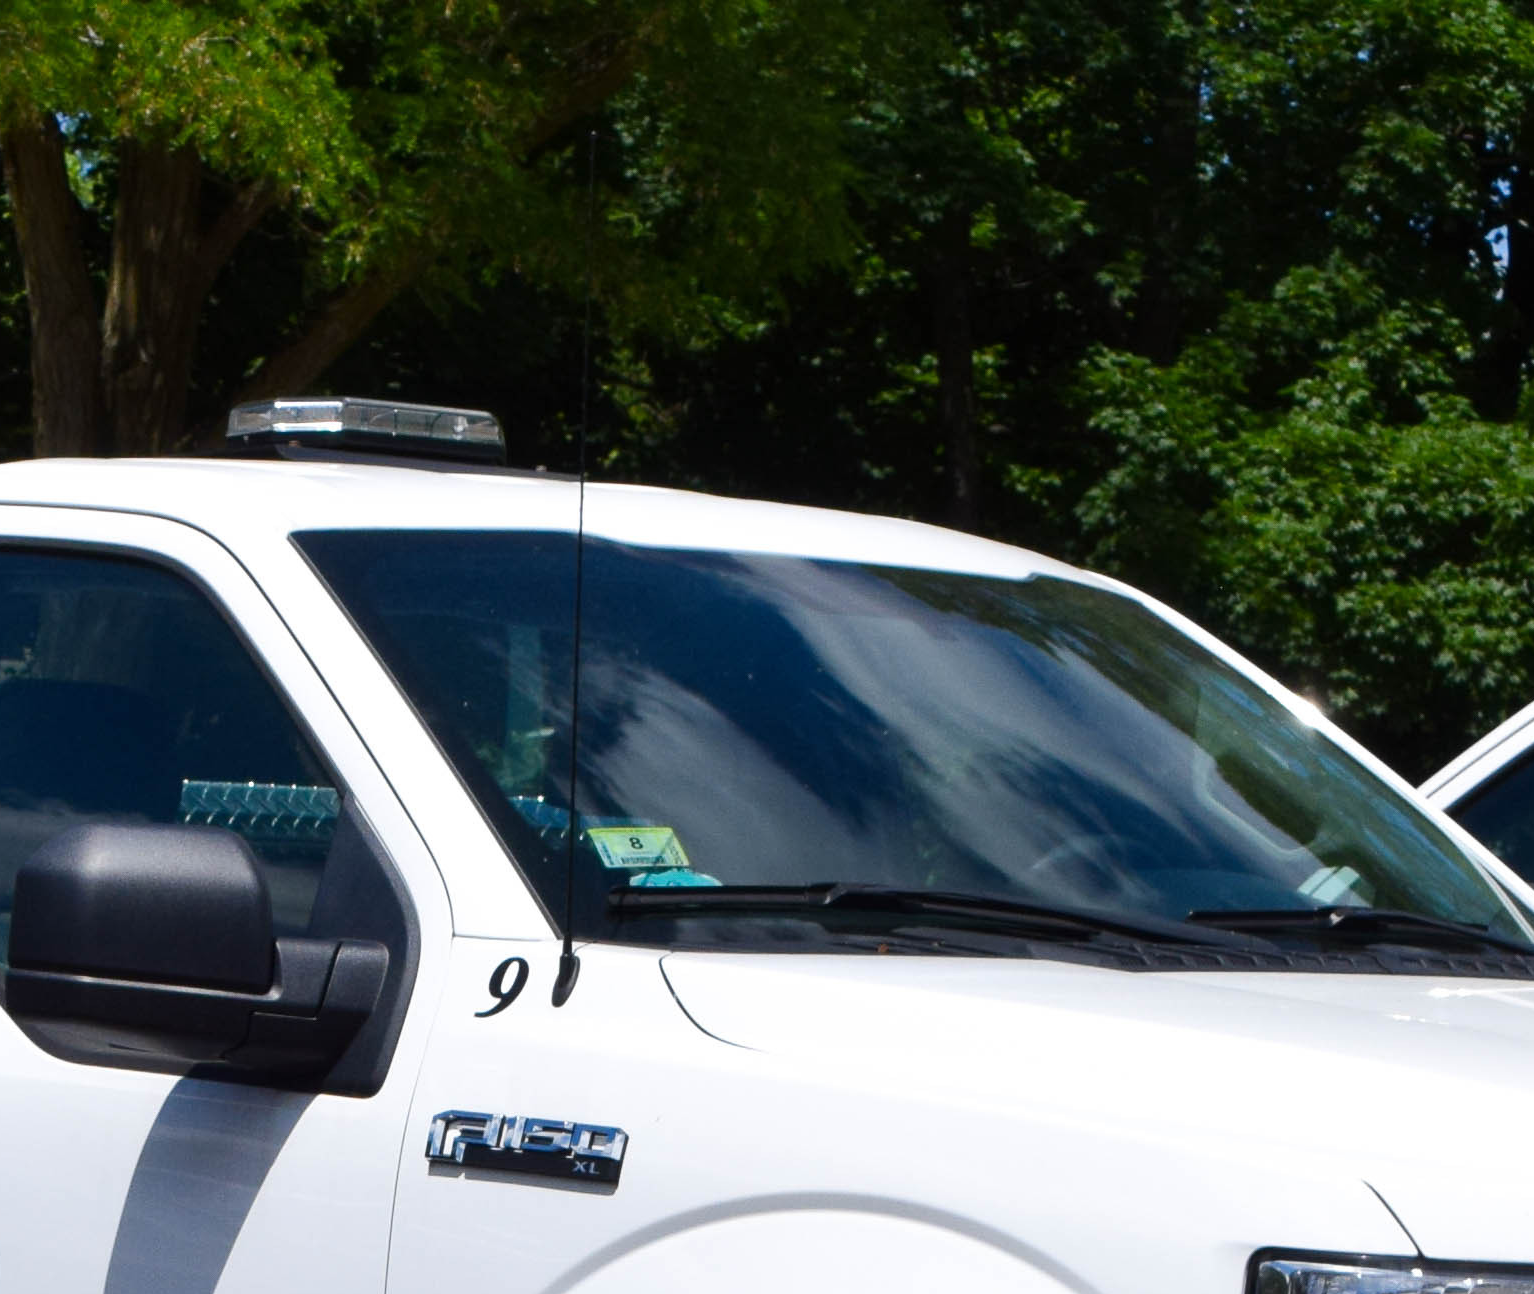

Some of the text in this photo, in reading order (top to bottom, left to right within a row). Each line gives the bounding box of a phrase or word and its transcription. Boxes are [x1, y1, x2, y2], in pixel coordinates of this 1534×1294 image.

[628, 836, 644, 850] 8
[473, 956, 530, 1018] 9
[572, 1161, 601, 1174] XL
